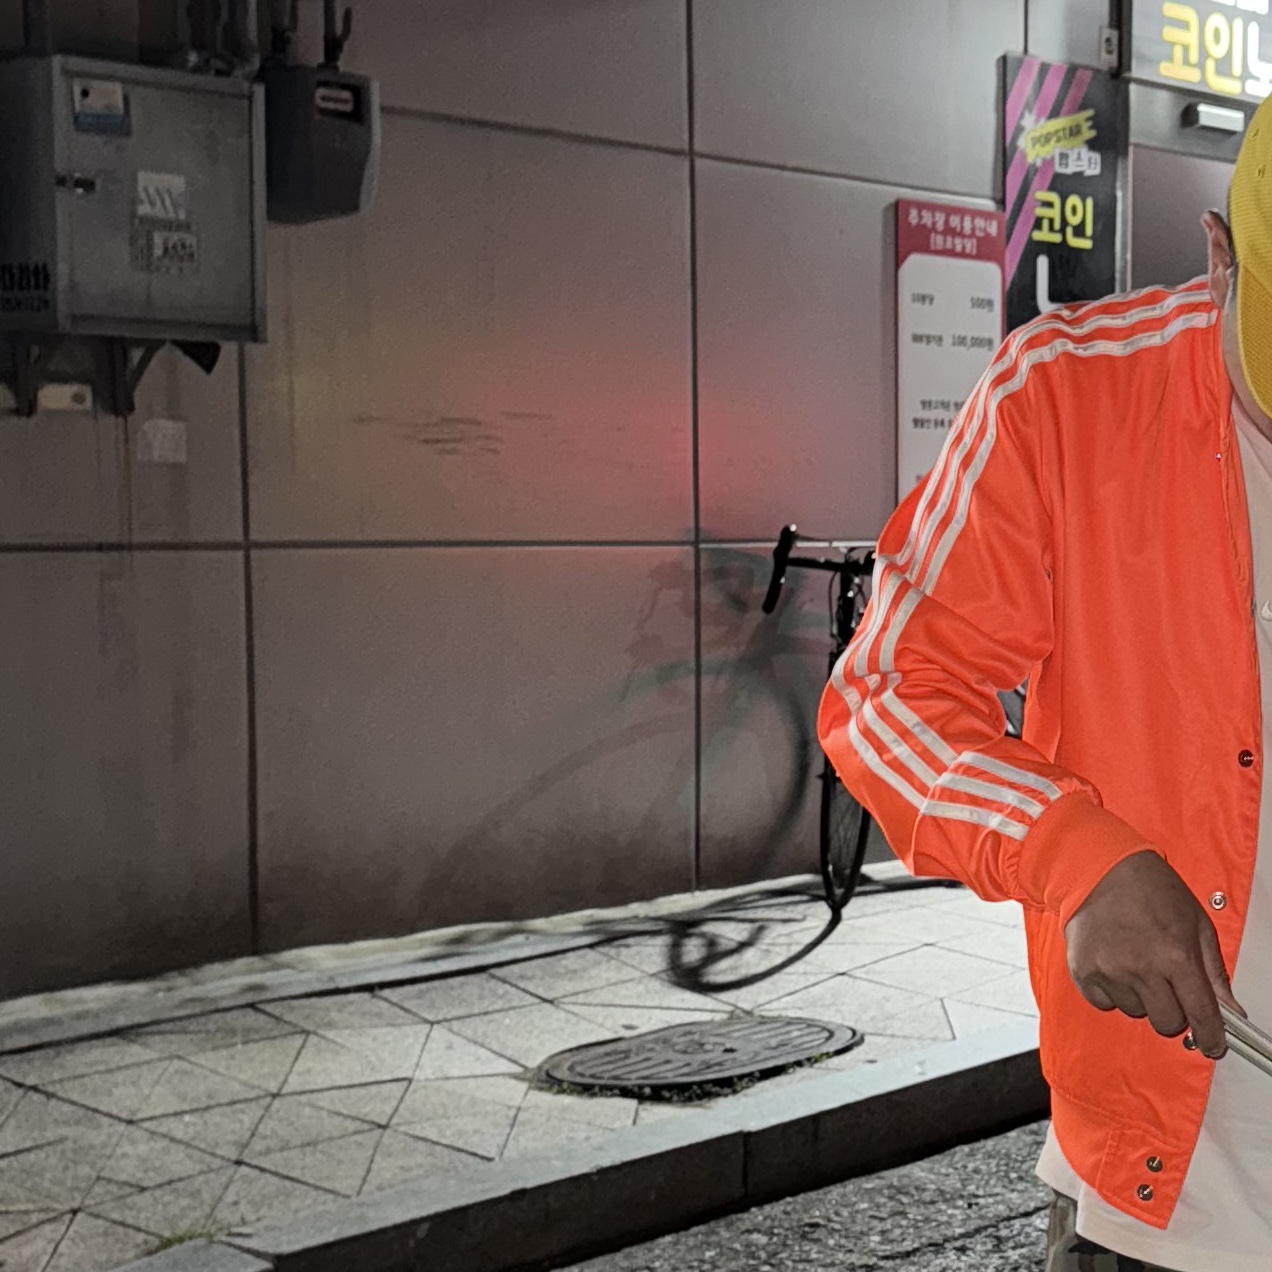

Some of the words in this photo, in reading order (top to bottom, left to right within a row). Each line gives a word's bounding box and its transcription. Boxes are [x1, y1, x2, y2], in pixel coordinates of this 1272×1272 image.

[1030, 123, 1084, 149] POPSTAR
[908, 207, 945, 232] 주차장
[949, 214, 998, 237] 이용안내
[1031, 190, 1094, 250] 코인
